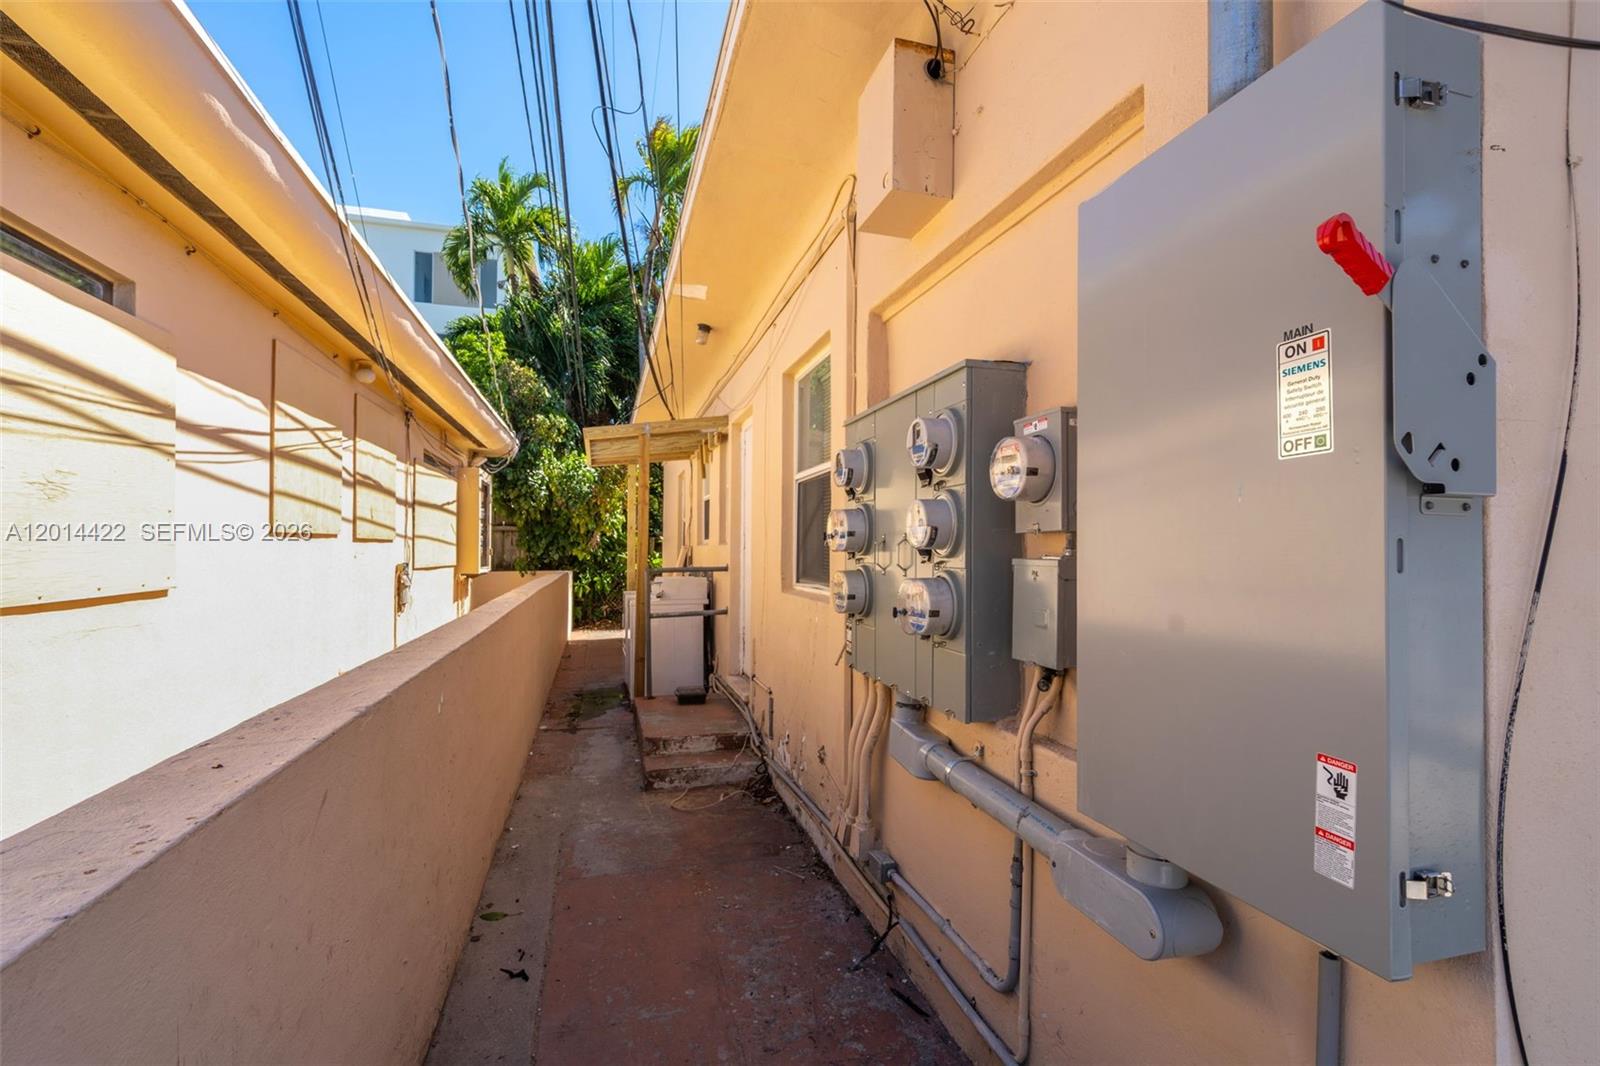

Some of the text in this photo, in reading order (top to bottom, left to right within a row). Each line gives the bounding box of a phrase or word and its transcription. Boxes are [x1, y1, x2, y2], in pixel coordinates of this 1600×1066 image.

[1283, 323, 1313, 342] MAIN
[1284, 341, 1307, 359] ON
[1281, 358, 1327, 378] SIEMENS
[1283, 436, 1313, 453] OFF
[1327, 757, 1355, 772] DANGER
[1325, 831, 1353, 849] DANGER
